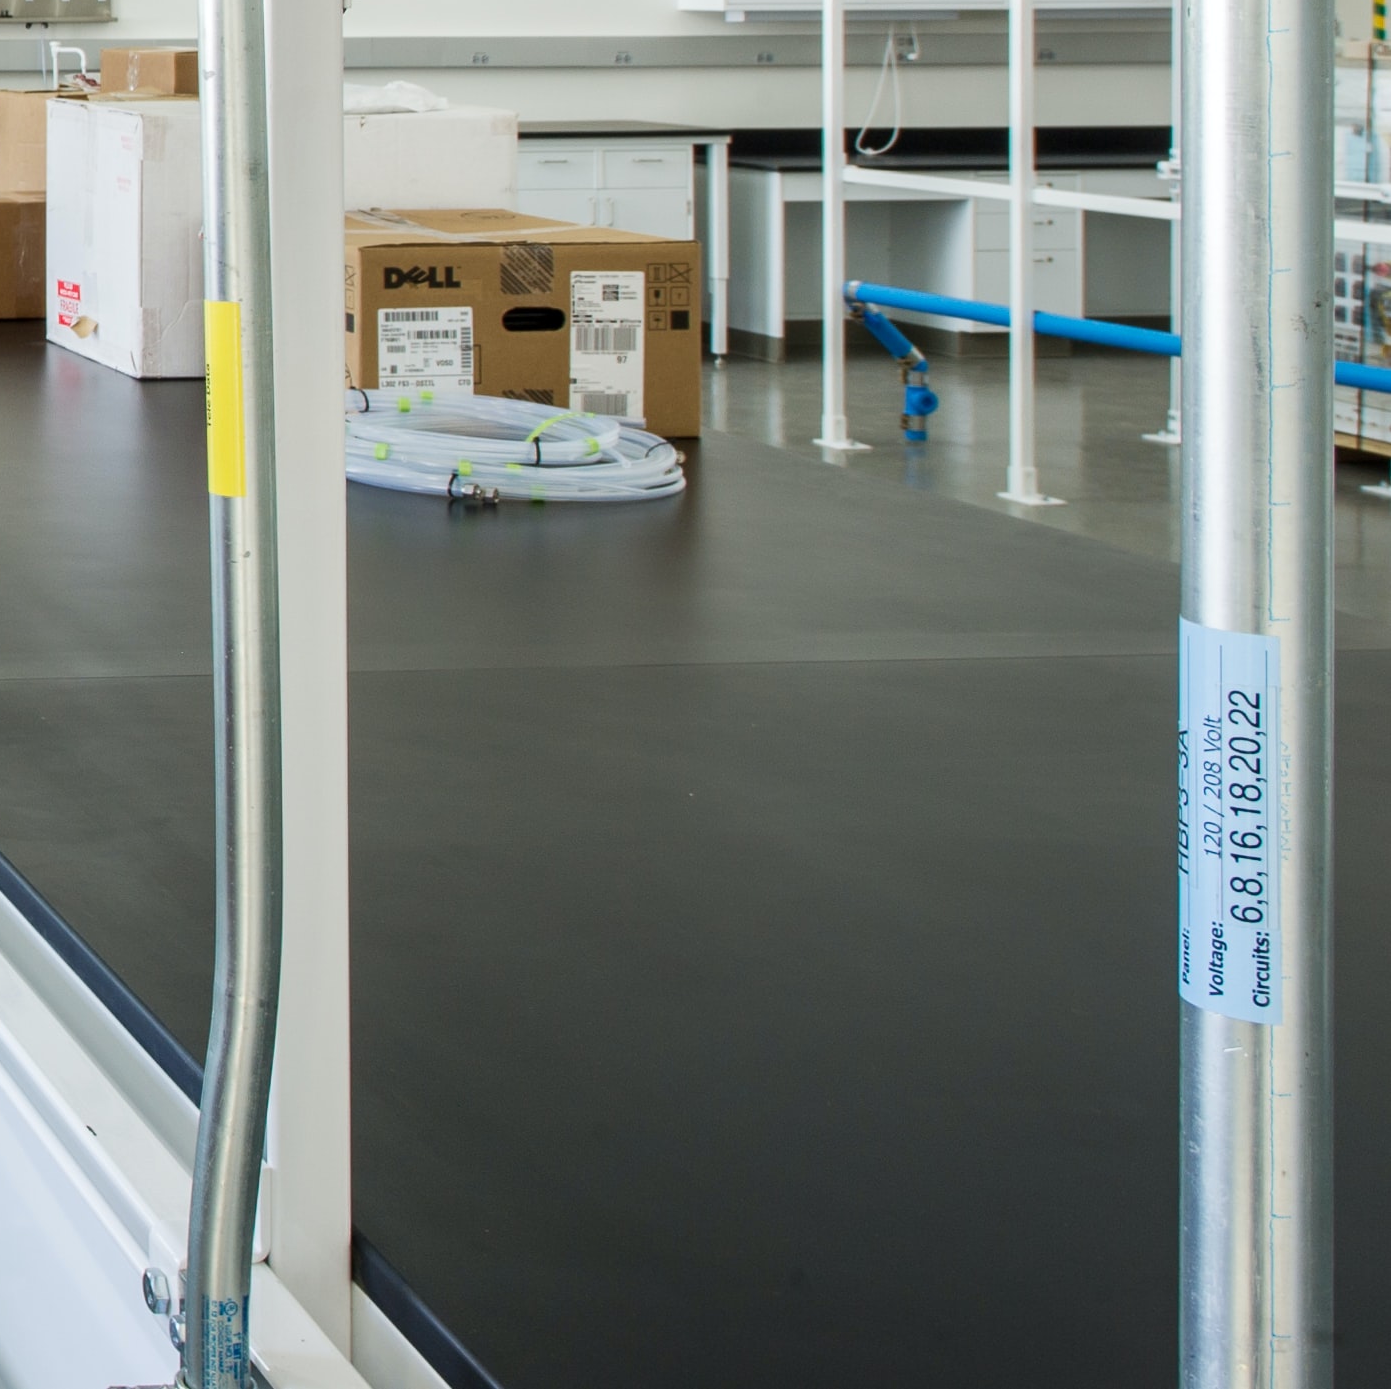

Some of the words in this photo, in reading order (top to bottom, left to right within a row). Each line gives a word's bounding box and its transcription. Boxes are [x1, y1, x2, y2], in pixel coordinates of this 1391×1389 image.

[384, 266, 461, 289] DELL
[1202, 714, 1222, 752] Volt
[1203, 761, 1222, 799] 208
[1204, 822, 1222, 859] 120
[1181, 927, 1191, 985] Panel:
[1208, 921, 1227, 997] Voltage:
[1251, 930, 1271, 1008] Circuits:
